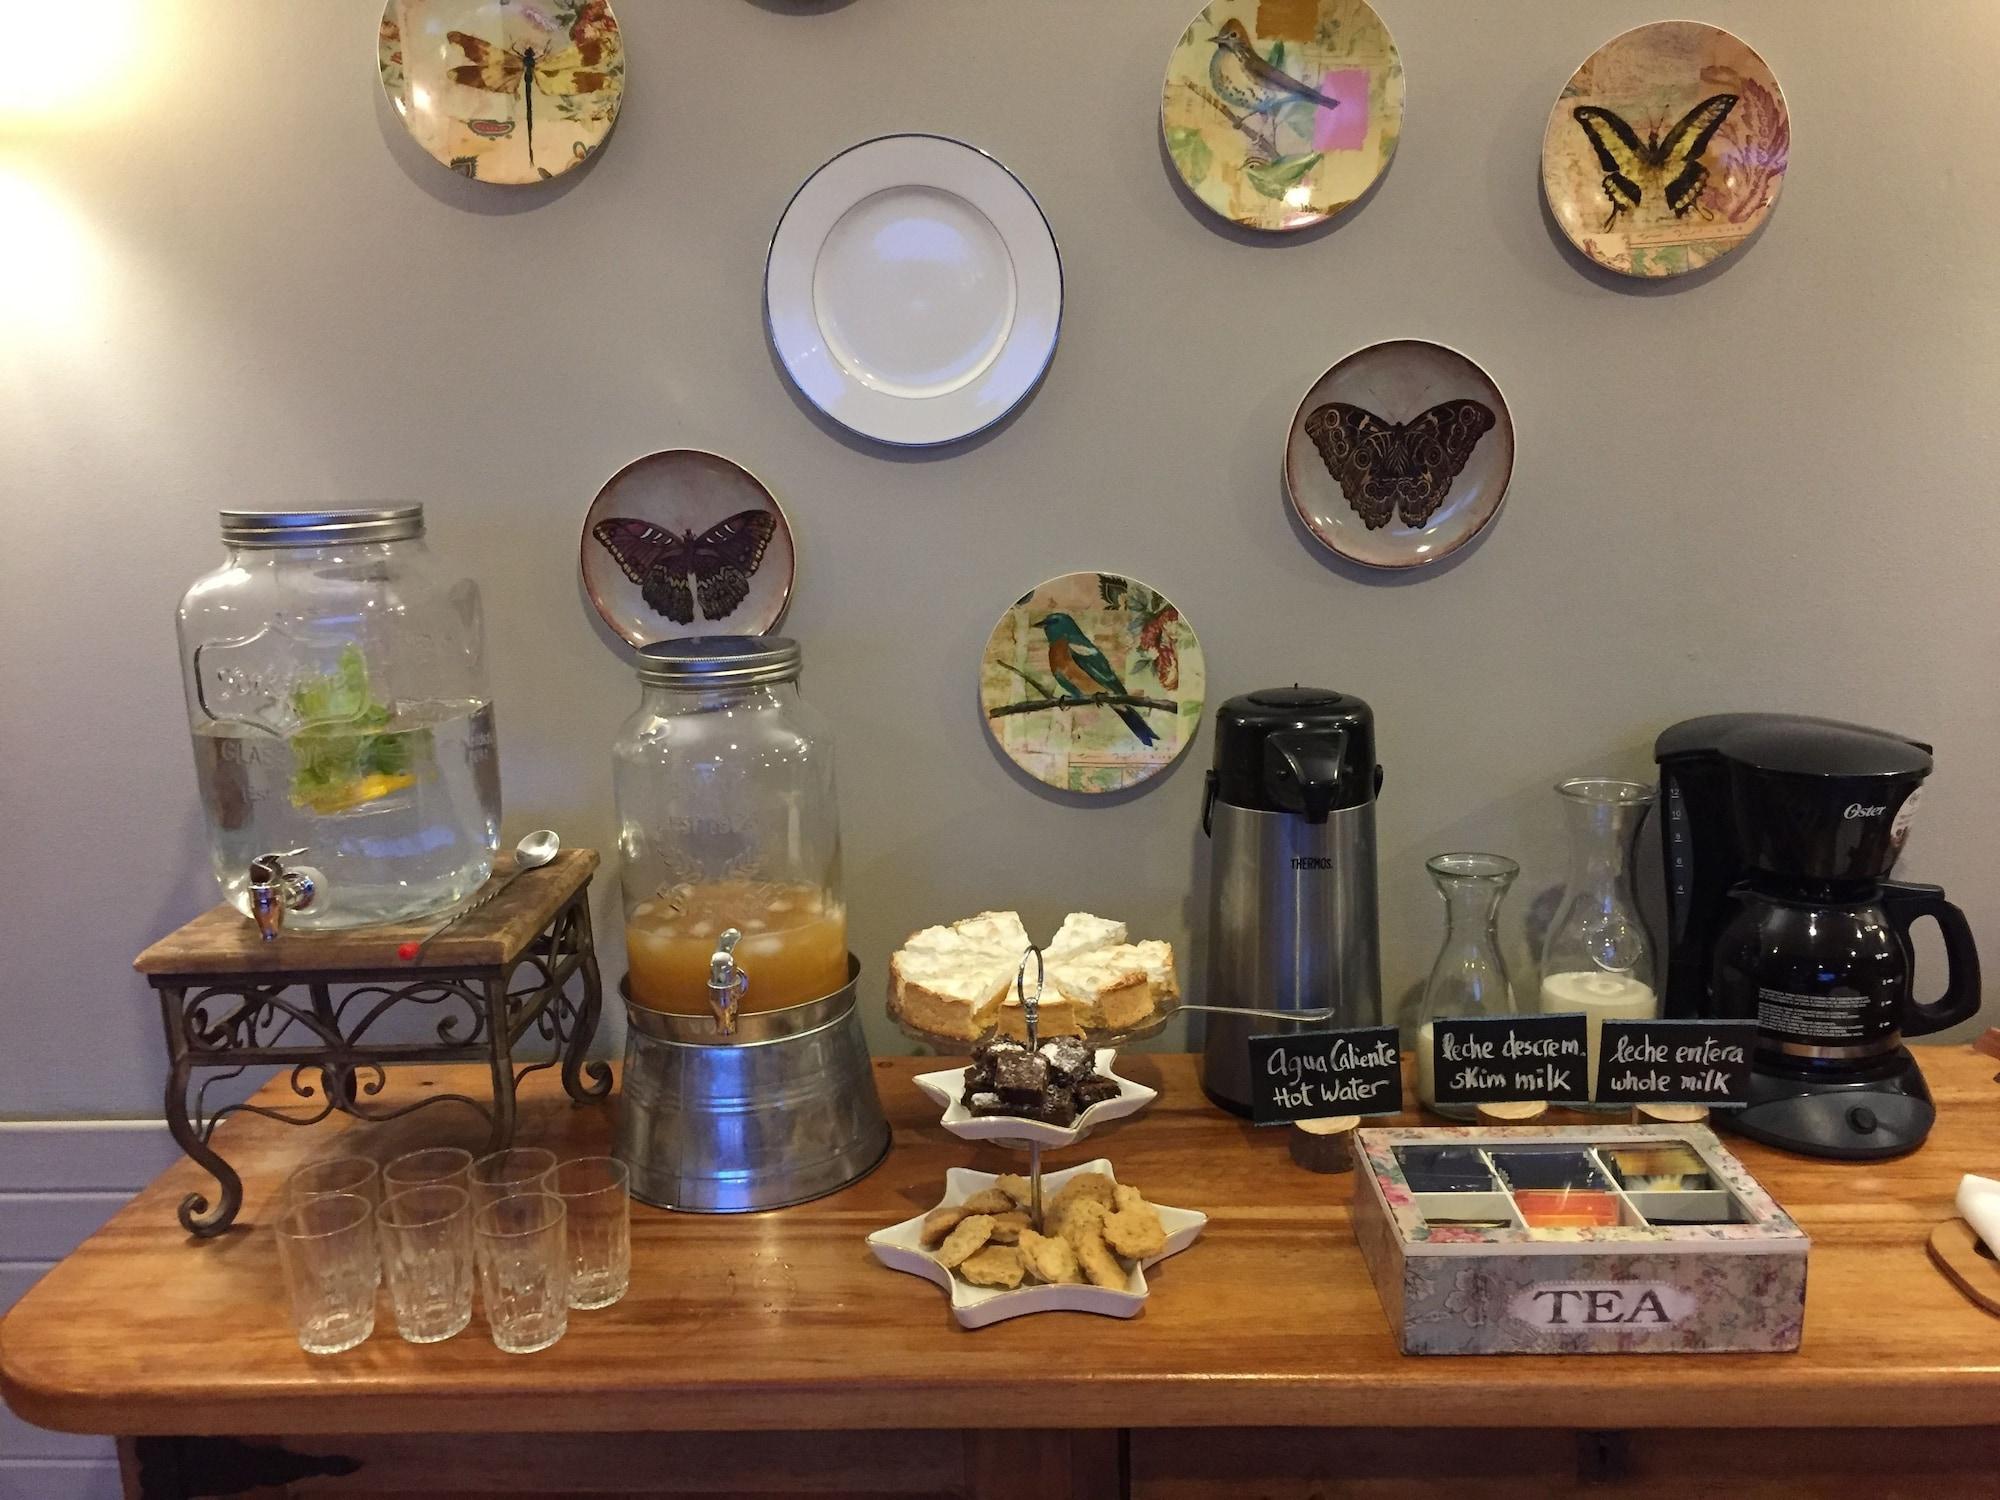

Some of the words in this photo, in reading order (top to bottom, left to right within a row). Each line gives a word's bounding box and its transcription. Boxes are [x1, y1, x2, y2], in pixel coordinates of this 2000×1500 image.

[1843, 803, 1886, 819] Oster
[1291, 857, 1333, 870] THERMOS
[1329, 1038, 1397, 1072] Caliente
[1441, 1032, 1495, 1061] leche
[1501, 1029, 1587, 1060] descrem.
[1609, 1033, 1669, 1064] leche
[1675, 1036, 1744, 1066] entera
[1272, 1081, 1314, 1108] Hot
[1320, 1077, 1390, 1103] Water
[1611, 1069, 1671, 1092] whole
[1533, 1289, 1671, 1324] TEA
